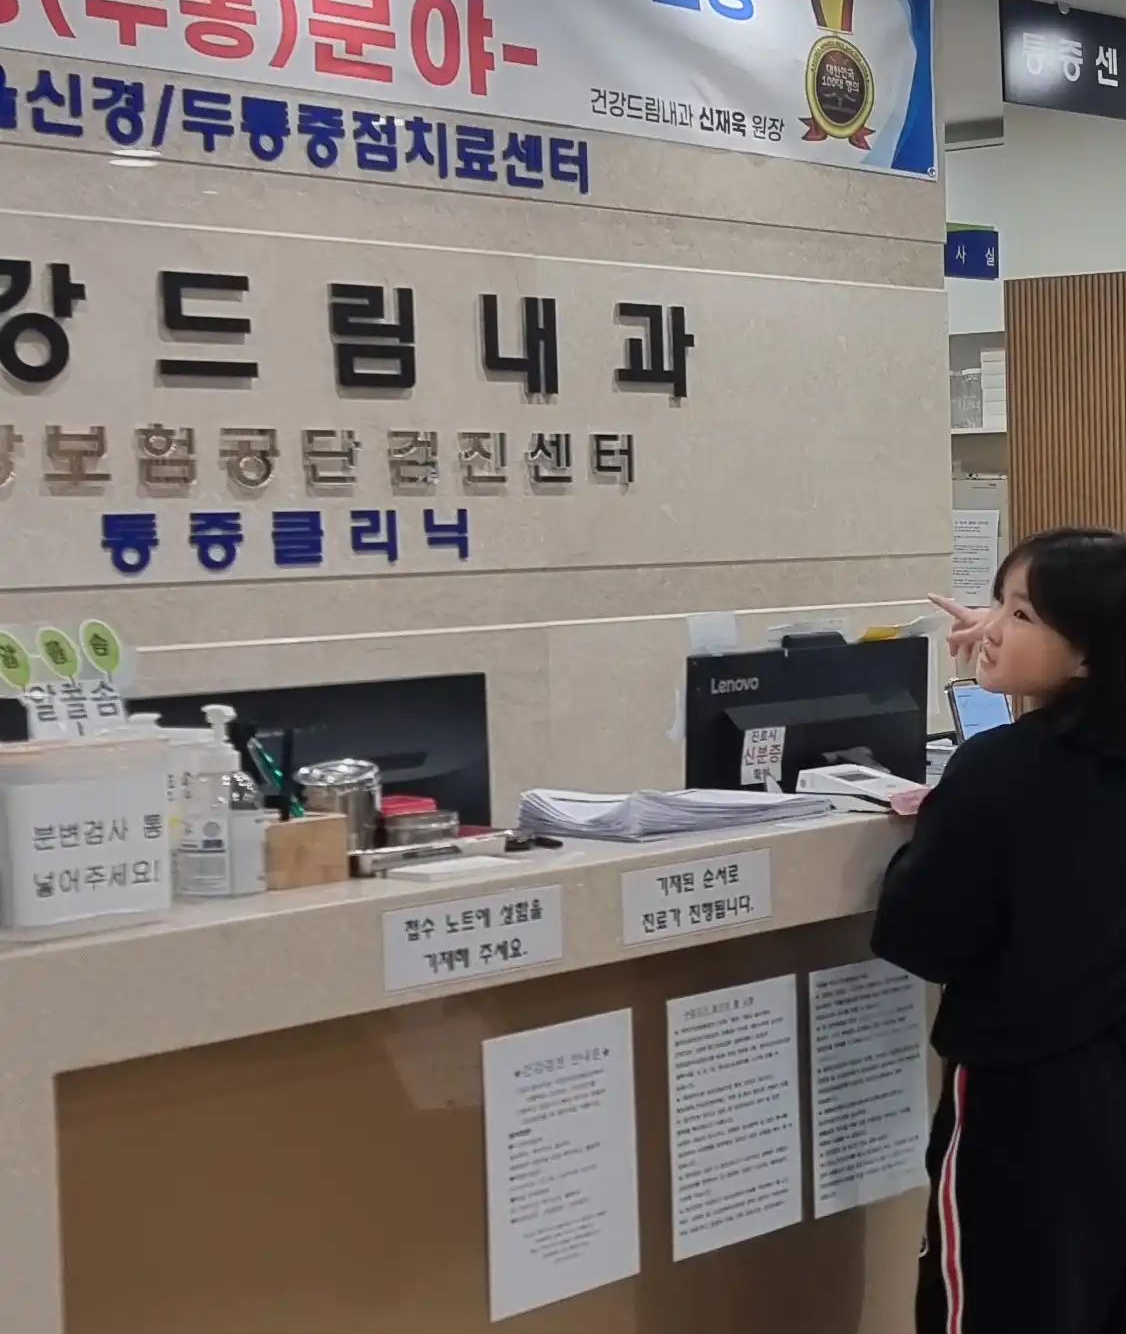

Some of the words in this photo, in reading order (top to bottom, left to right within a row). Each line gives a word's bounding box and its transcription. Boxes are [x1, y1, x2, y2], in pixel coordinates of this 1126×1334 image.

[590, 88, 693, 127] 건강드림내과
[699, 107, 746, 136] 신재욱
[752, 115, 785, 142] 원장
[101, 509, 469, 574] 통증클리닉
[711, 676, 759, 694] Lenovo
[656, 871, 695, 898] 기재된
[703, 865, 739, 890] 순서로
[404, 917, 434, 942] 접수
[445, 908, 491, 935] 노트에
[499, 899, 544, 927] 성함을
[641, 908, 682, 934] 진료가
[424, 945, 470, 974] 기재해
